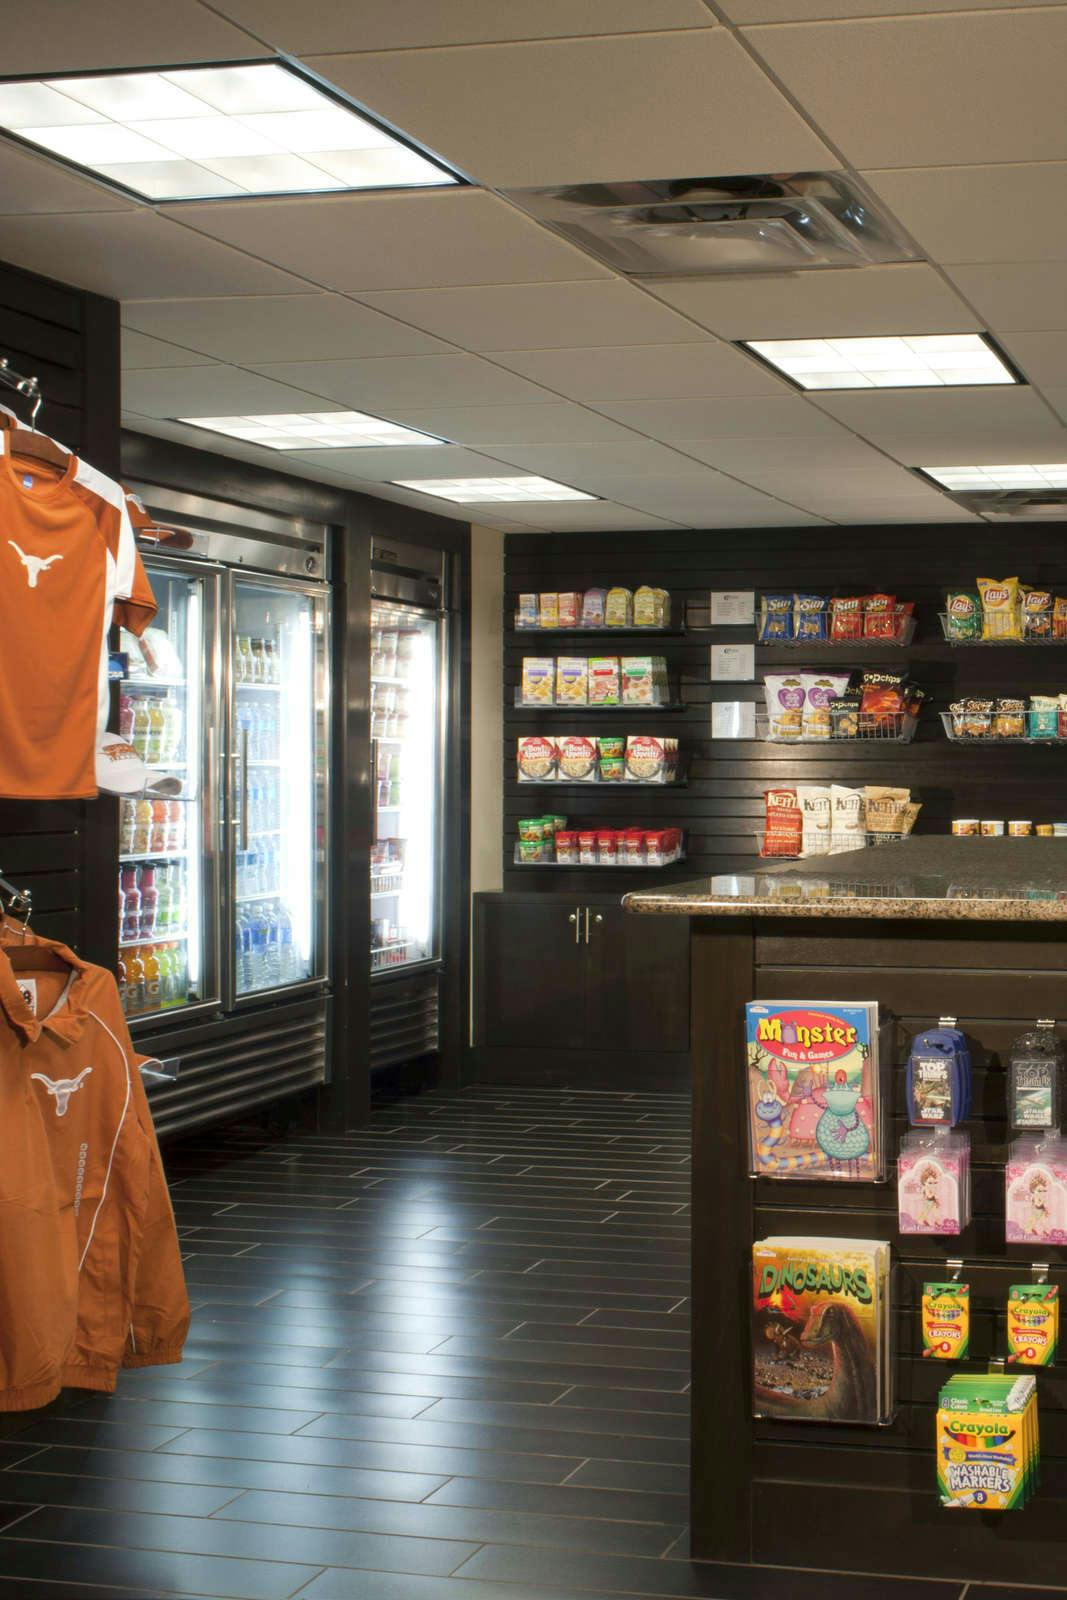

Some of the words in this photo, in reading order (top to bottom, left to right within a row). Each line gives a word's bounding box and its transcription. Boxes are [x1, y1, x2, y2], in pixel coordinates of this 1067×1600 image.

[800, 599, 824, 611] Sun
[758, 1018, 857, 1048] Monster
[782, 1048, 798, 1059] Fun
[807, 1051, 834, 1059] Games
[919, 1062, 946, 1072] TOP
[759, 1263, 872, 1302] DINOSAURS
[928, 1302, 961, 1310] Crayola
[1014, 1306, 1049, 1316] Crayola
[928, 1329, 961, 1339] CRAYONS
[1013, 1336, 1047, 1345] CRAYONS
[949, 1420, 1009, 1436] Crayola
[950, 1464, 1009, 1481] WASHABLE
[950, 1476, 1011, 1492] MARKERS
[977, 1493, 984, 1502] 8
